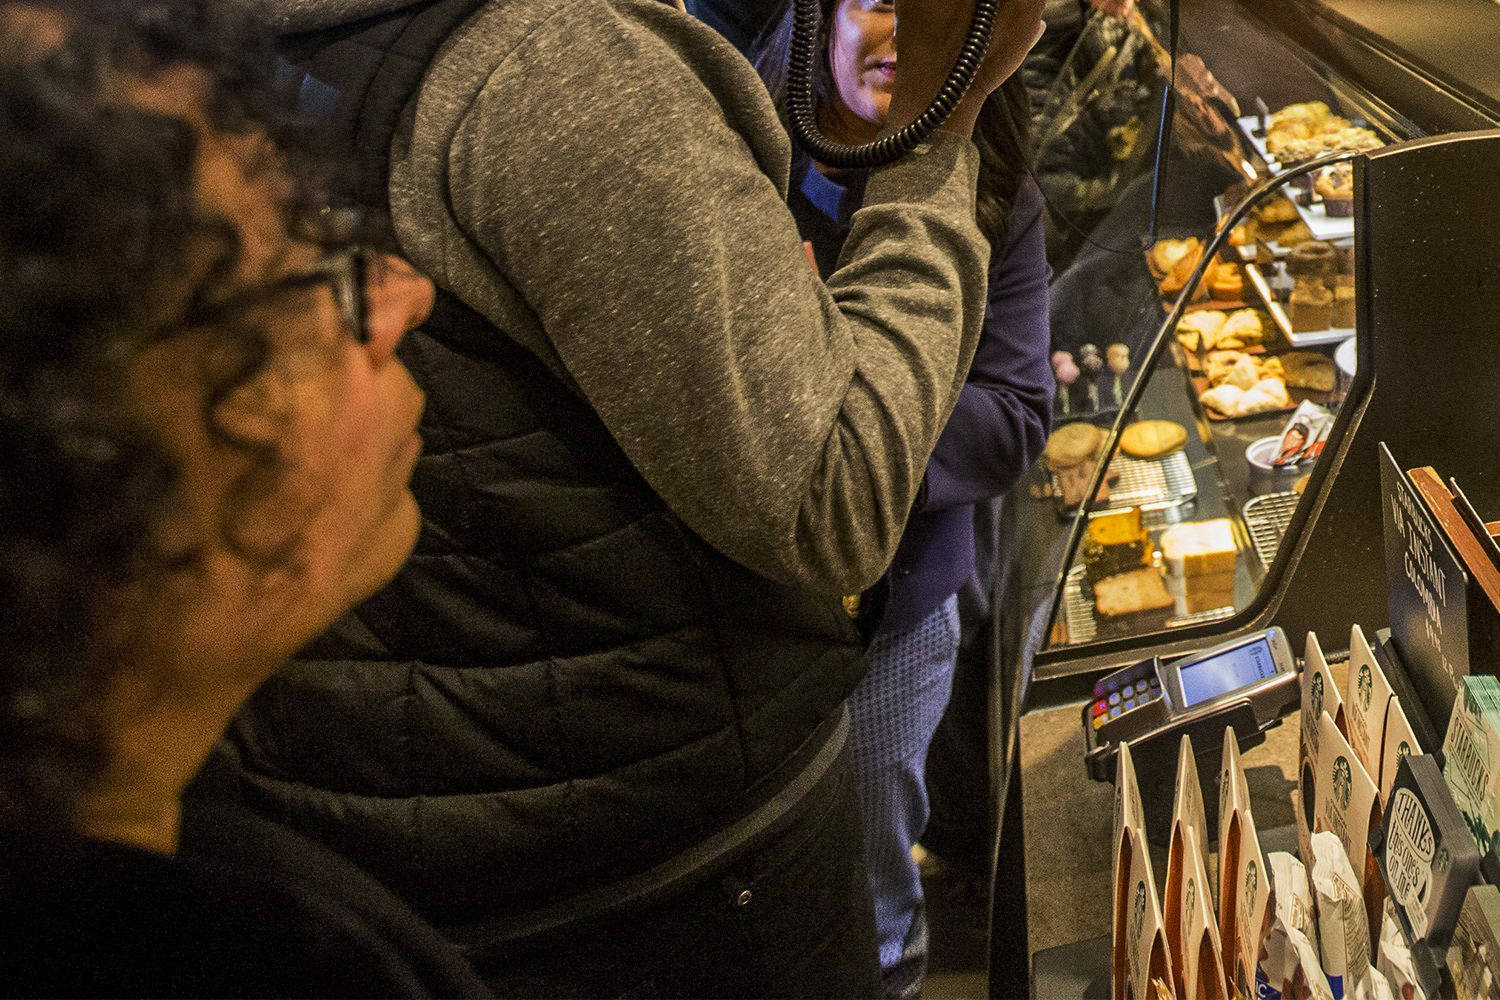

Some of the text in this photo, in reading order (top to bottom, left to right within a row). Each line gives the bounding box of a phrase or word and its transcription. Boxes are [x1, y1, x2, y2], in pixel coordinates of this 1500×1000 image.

[1406, 520, 1447, 607] INSTANT
[1450, 716, 1490, 802] STARBUCKS
[1396, 792, 1433, 857] THANKS
